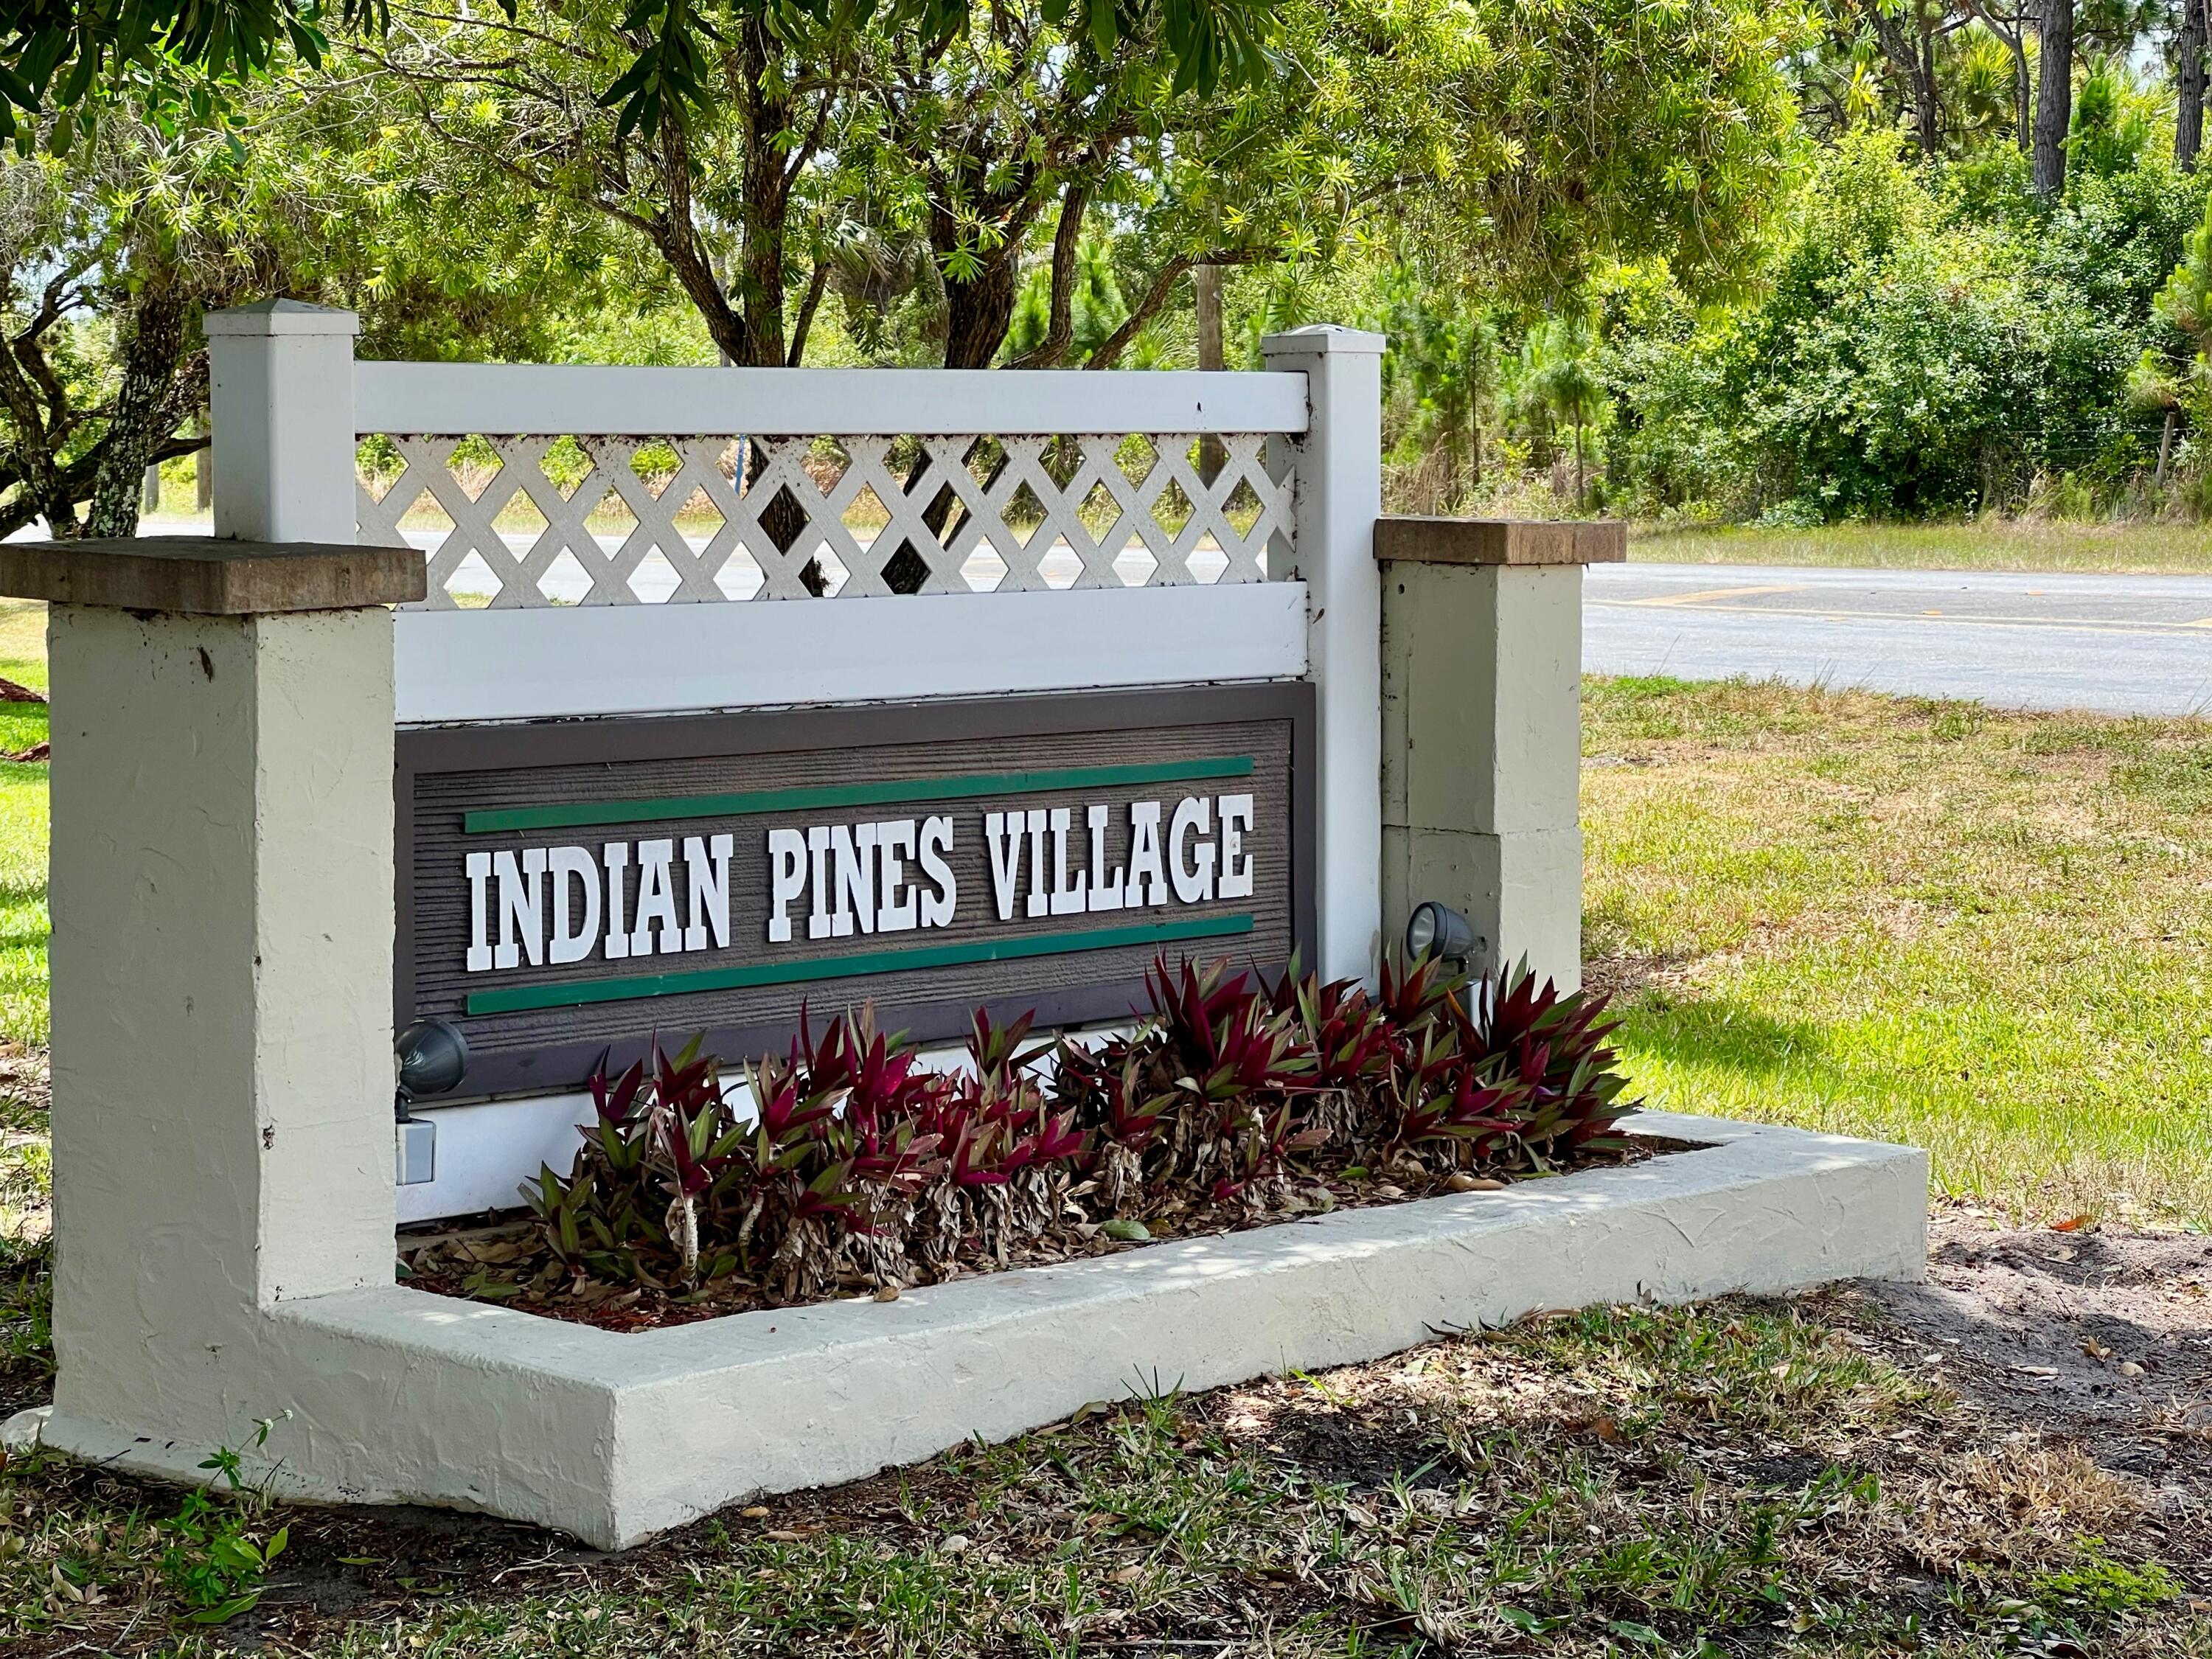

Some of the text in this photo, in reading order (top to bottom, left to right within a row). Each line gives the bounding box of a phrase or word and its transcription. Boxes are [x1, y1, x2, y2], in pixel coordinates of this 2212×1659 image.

[465, 793, 1254, 973] INDIAN PINES VILLAGE
